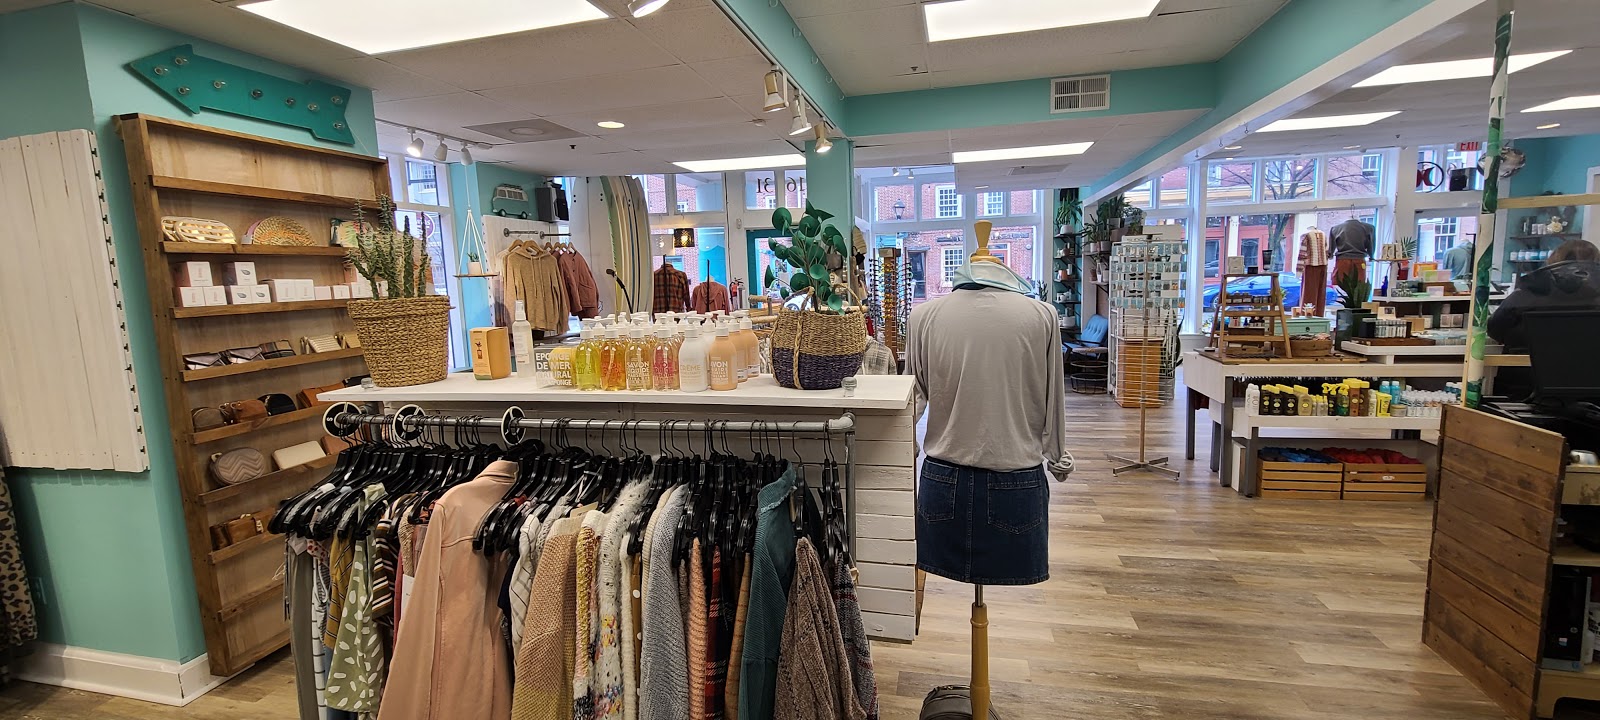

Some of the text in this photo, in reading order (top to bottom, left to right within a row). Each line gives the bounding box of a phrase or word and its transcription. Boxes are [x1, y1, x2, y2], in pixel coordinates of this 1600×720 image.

[536, 361, 571, 370] DE MER
[536, 370, 572, 379] NATURAL
